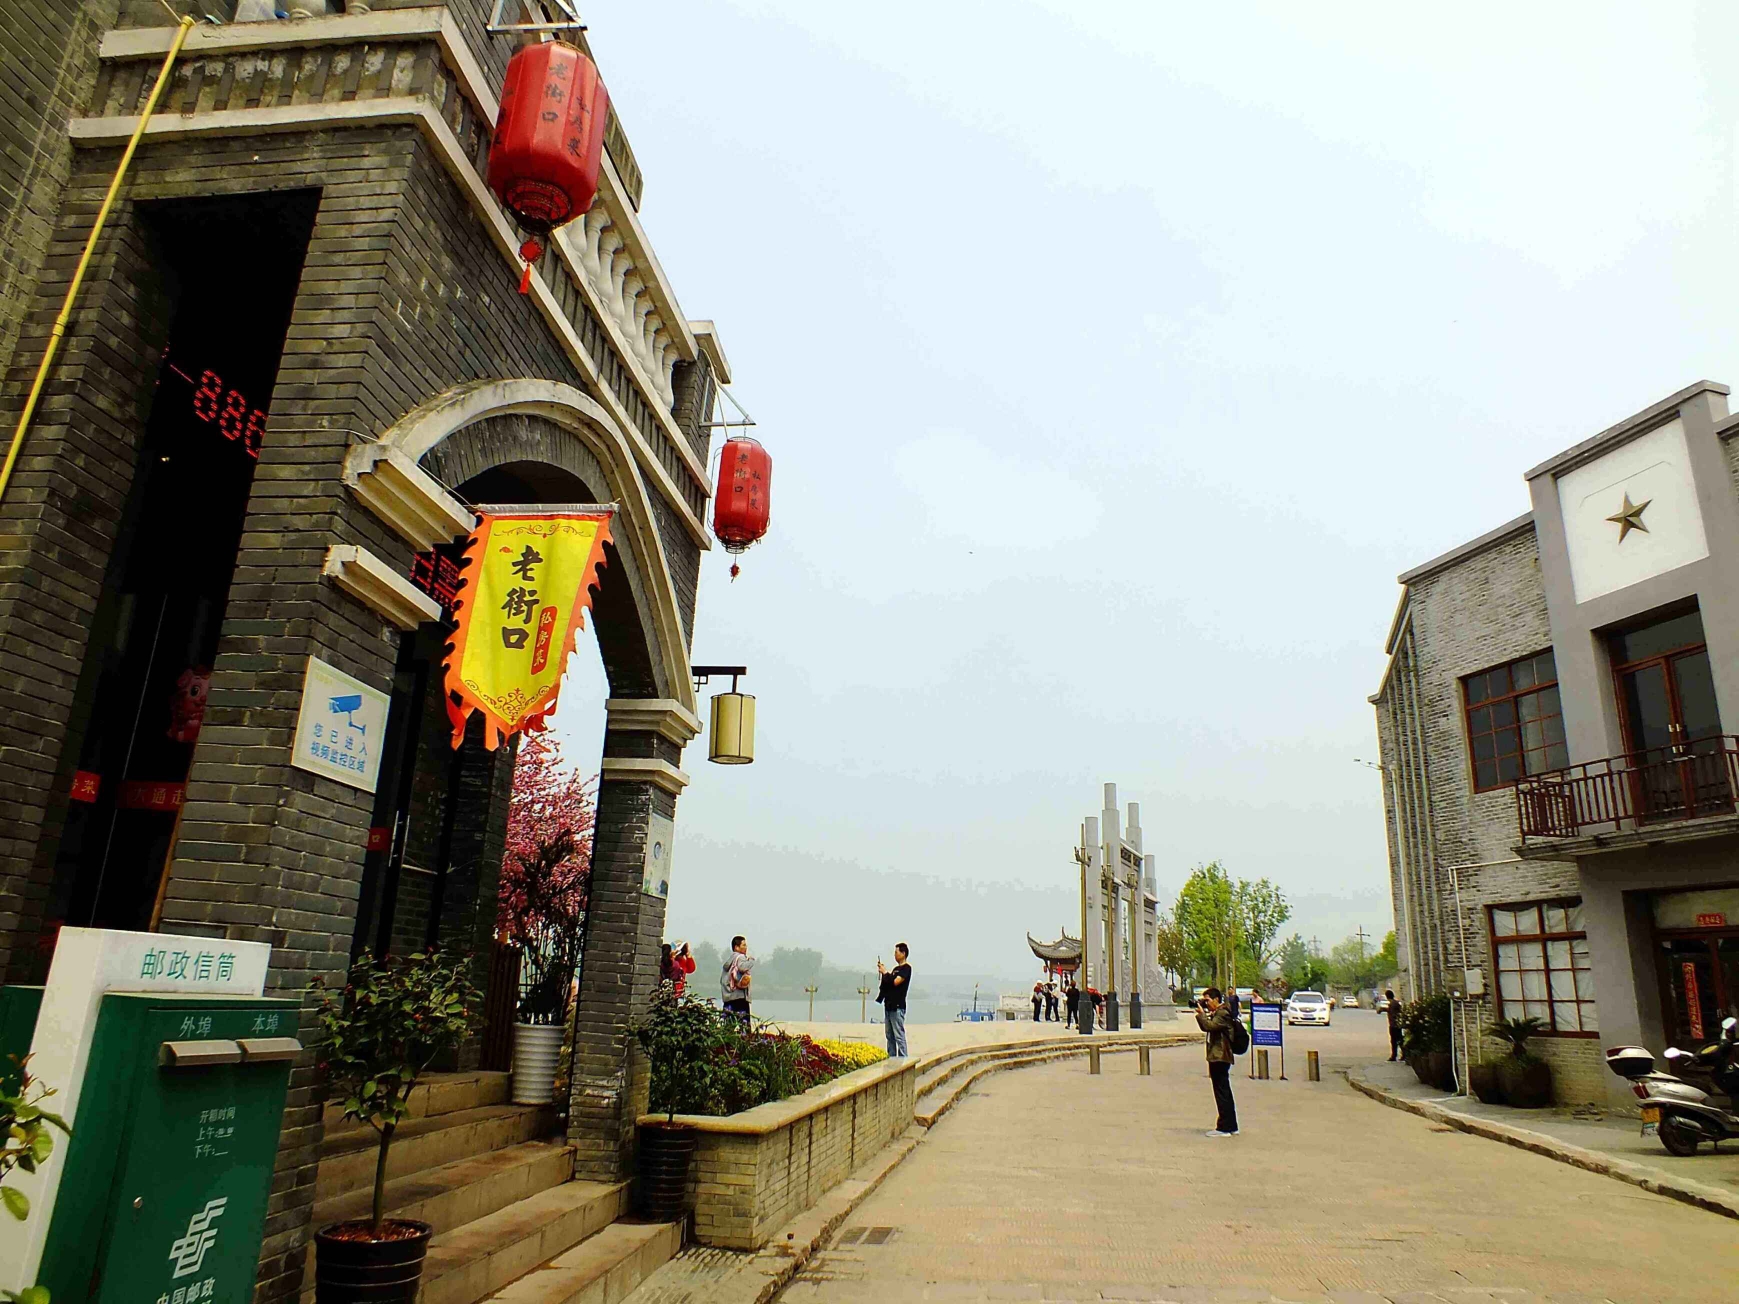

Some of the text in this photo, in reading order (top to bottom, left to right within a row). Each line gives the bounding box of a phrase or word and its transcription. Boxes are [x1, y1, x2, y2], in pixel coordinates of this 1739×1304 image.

[501, 545, 544, 650] 老街口
[310, 740, 366, 773] 视频监控区域
[140, 947, 236, 981] 邮政信筒
[178, 1016, 212, 1038] 外埠
[251, 1013, 279, 1034] 本埠
[156, 1276, 216, 1304] 中国邮政
